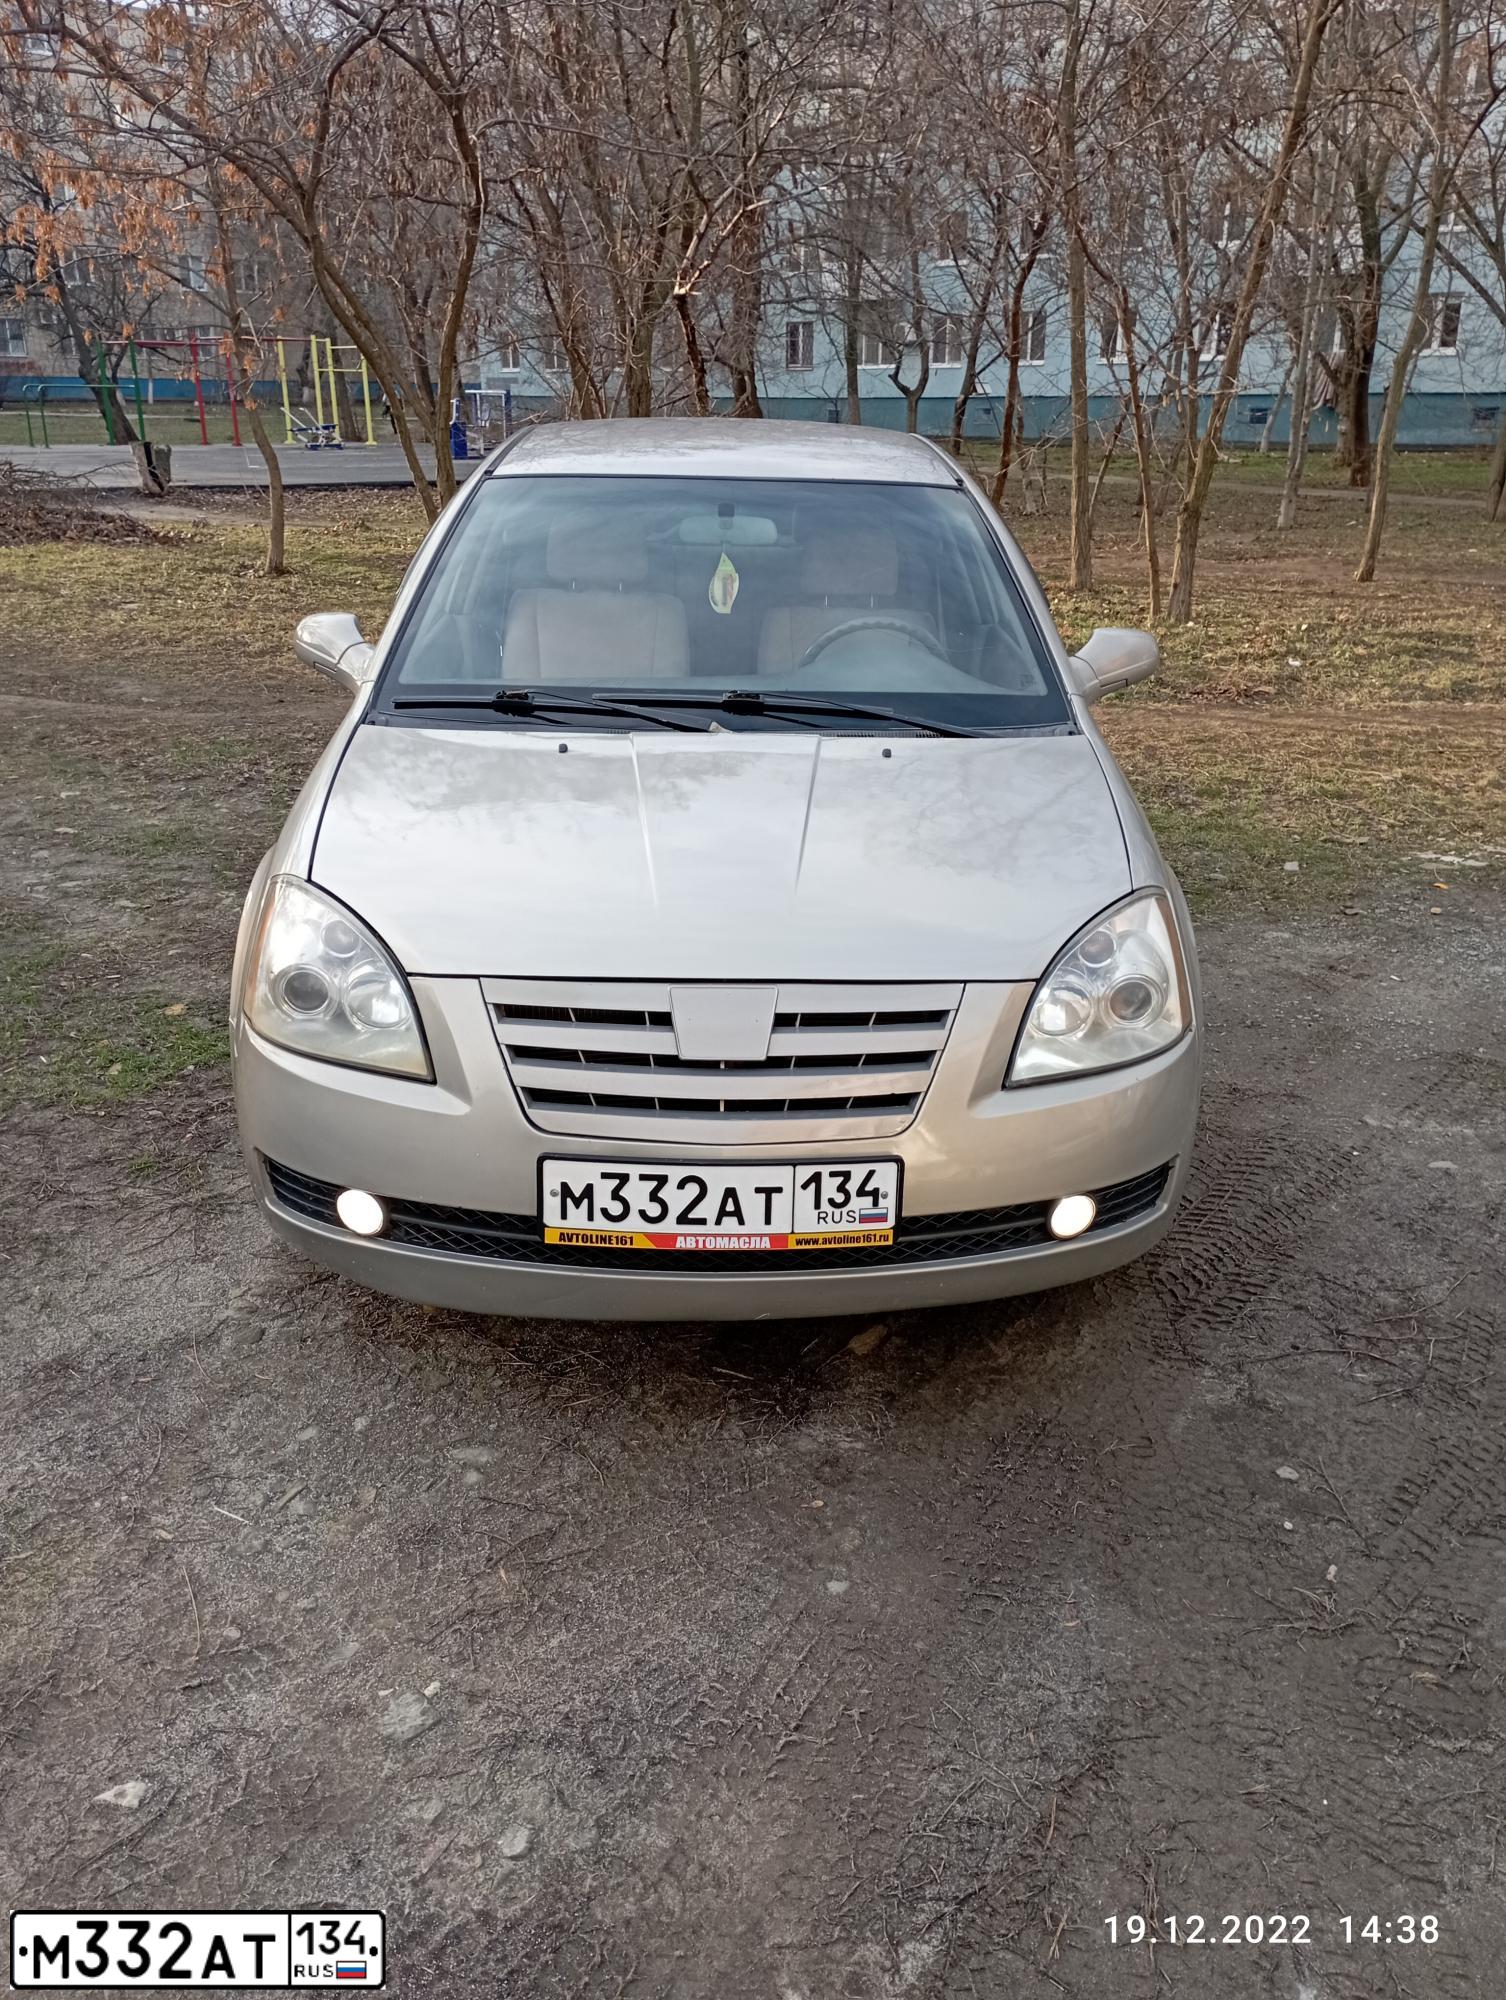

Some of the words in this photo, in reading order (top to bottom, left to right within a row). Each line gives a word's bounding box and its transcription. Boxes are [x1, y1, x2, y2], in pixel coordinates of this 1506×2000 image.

[800, 1169, 880, 1211] 134
[817, 1210, 857, 1225] RUS
[558, 1232, 634, 1246] AVTOLINE161
[675, 1234, 771, 1249] АВТОМАСЛА
[795, 1232, 890, 1246] www.avtoline161.ru
